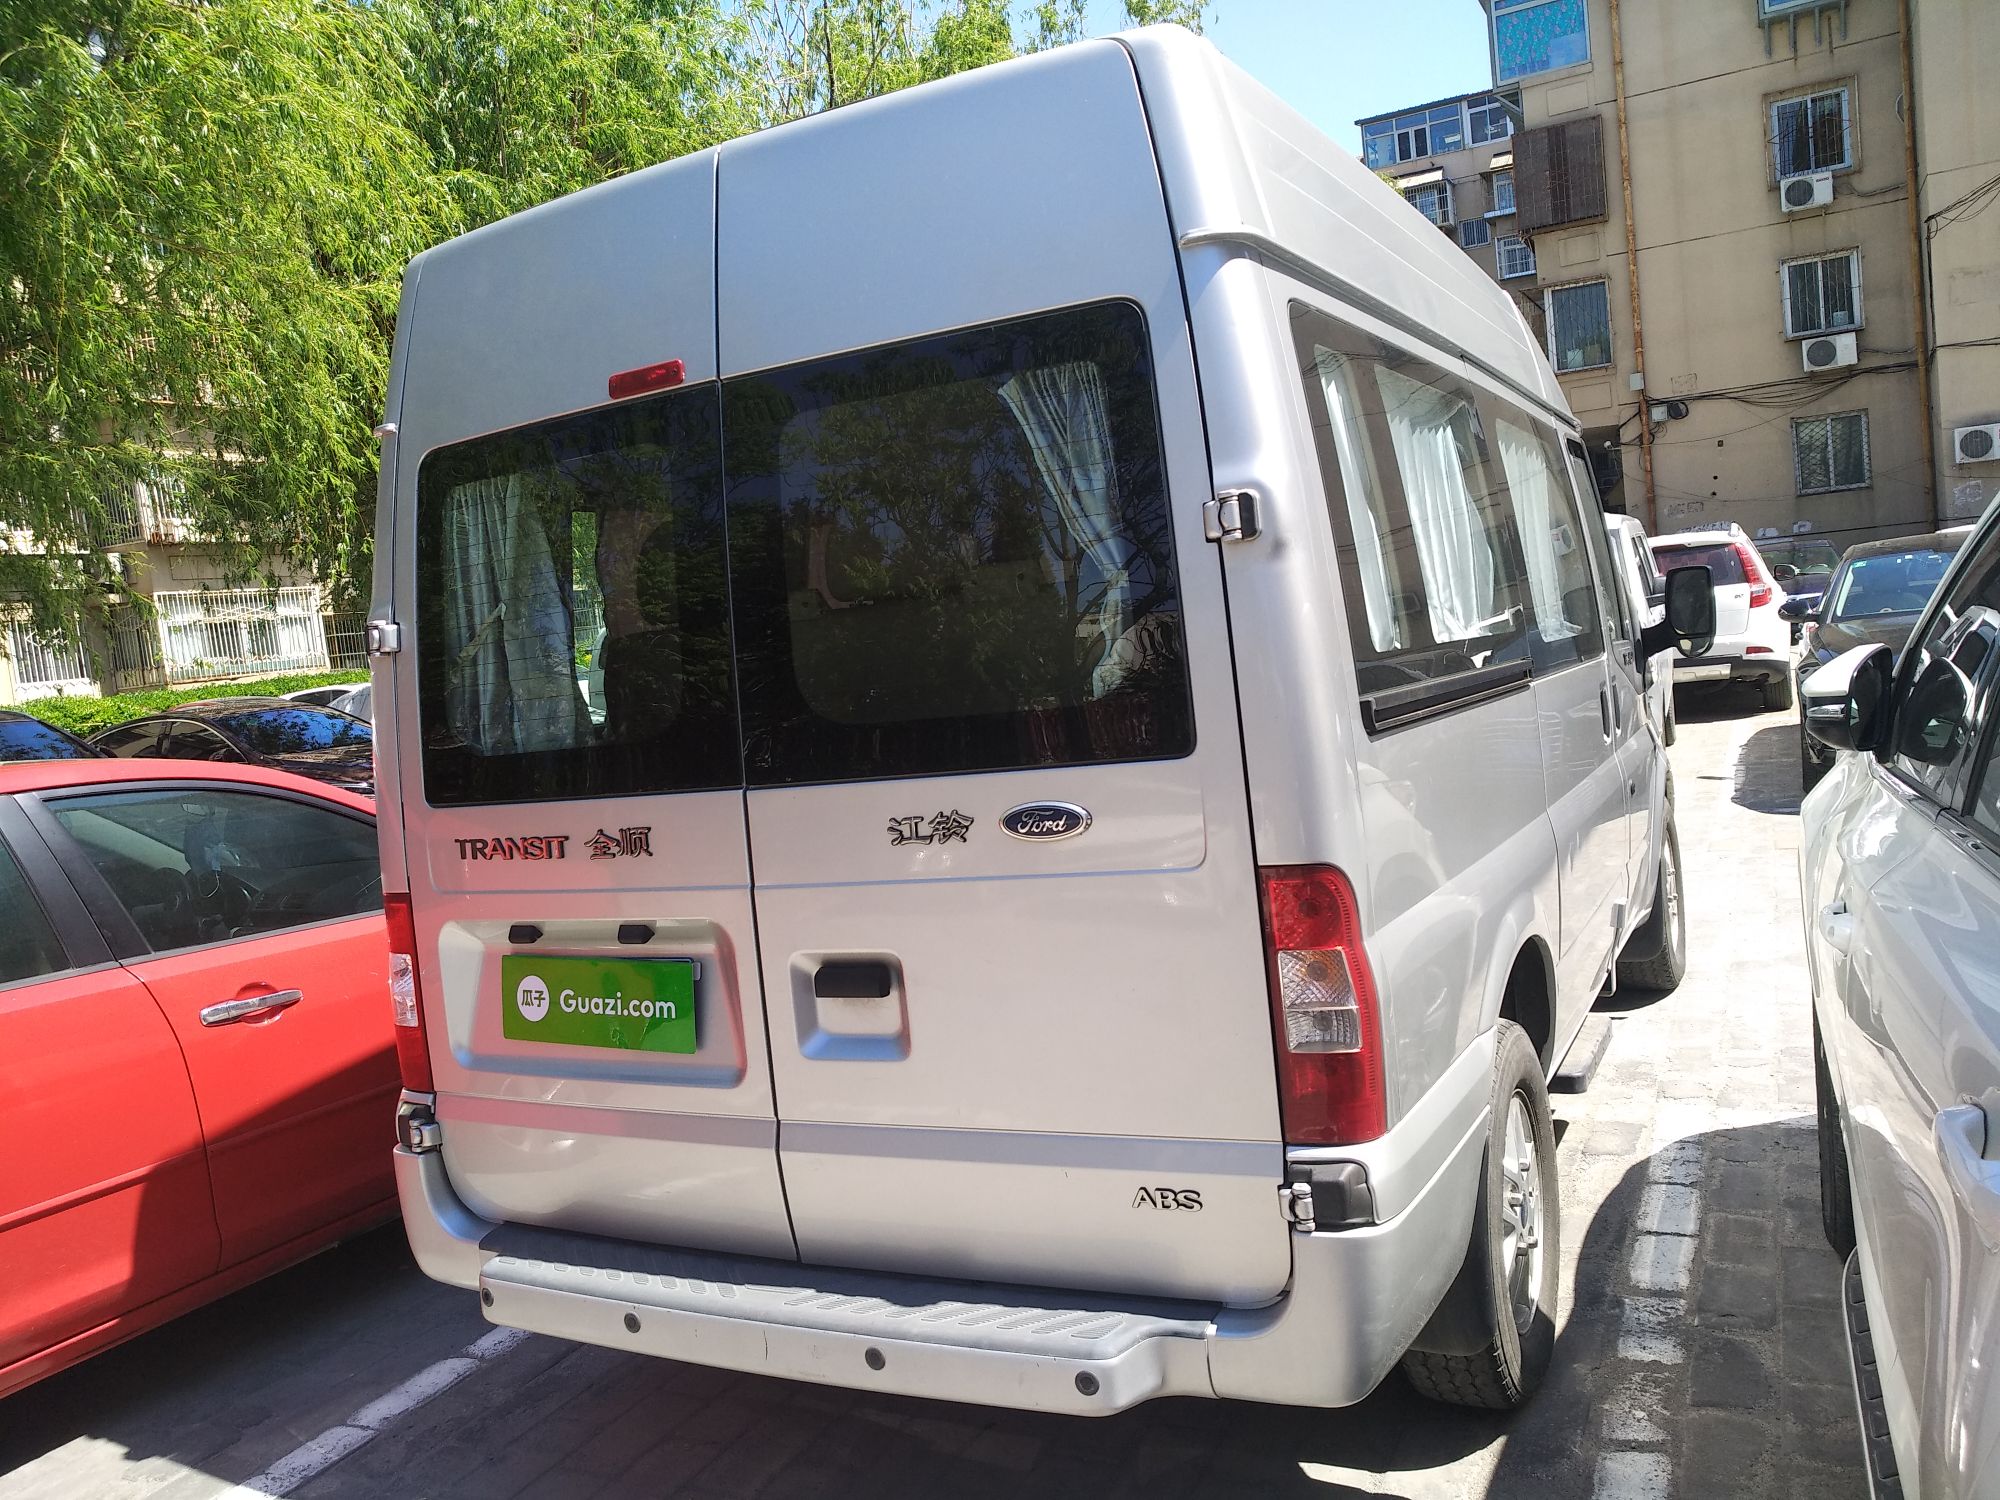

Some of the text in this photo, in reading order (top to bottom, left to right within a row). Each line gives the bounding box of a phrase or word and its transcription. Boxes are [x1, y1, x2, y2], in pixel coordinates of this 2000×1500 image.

[887, 809, 974, 846] 江铃
[1017, 810, 1068, 833] Ford
[454, 826, 654, 861] TRANSIT 全顺
[521, 989, 546, 1008] 瓜子
[559, 988, 676, 1019] Guazi.com
[1132, 1186, 1203, 1212] ABS
